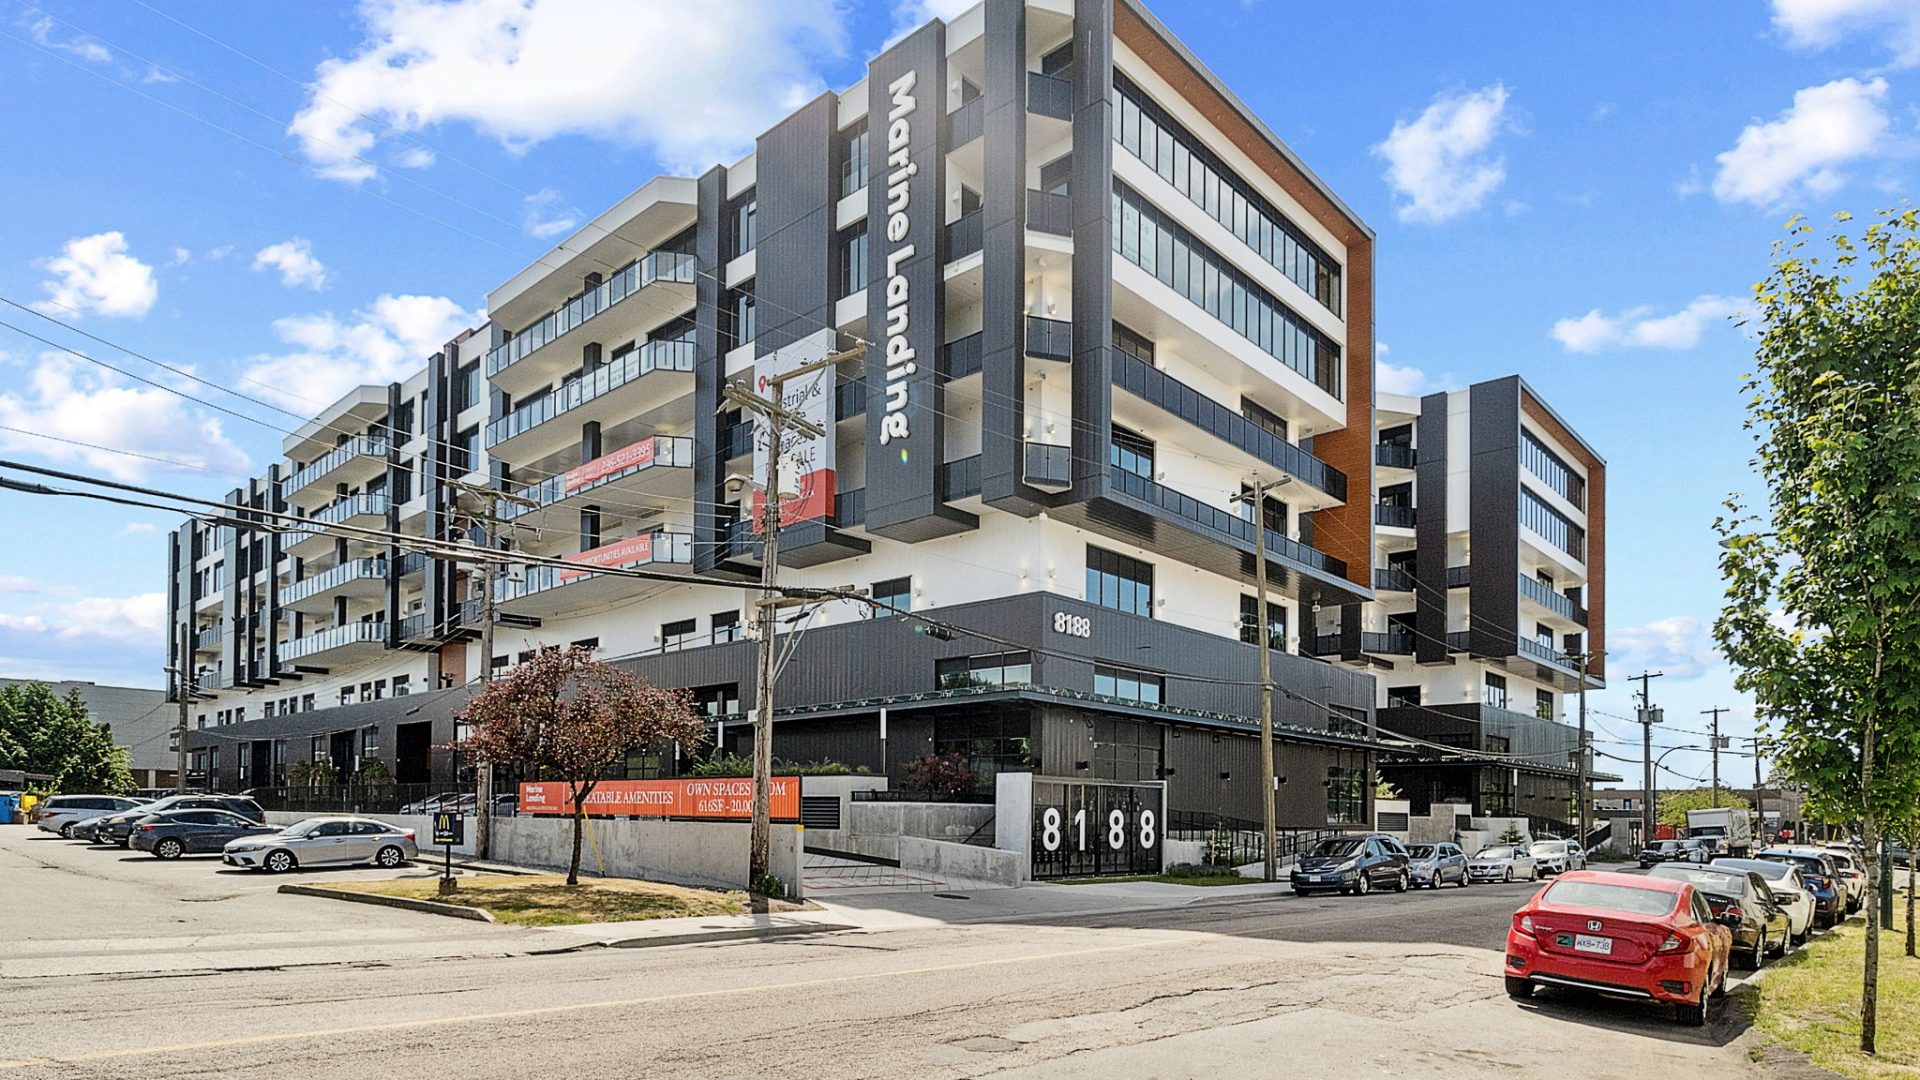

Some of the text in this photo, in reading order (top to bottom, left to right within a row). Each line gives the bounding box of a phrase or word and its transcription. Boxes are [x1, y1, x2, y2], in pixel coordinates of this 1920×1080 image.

[879, 70, 917, 446] Marine Landing
[1054, 611, 1091, 638] 8188
[526, 785, 543, 793] Marine
[686, 782, 712, 796] OWN
[713, 782, 751, 796] SPACES
[526, 793, 545, 804] Landing
[623, 790, 674, 805] AMENITIES
